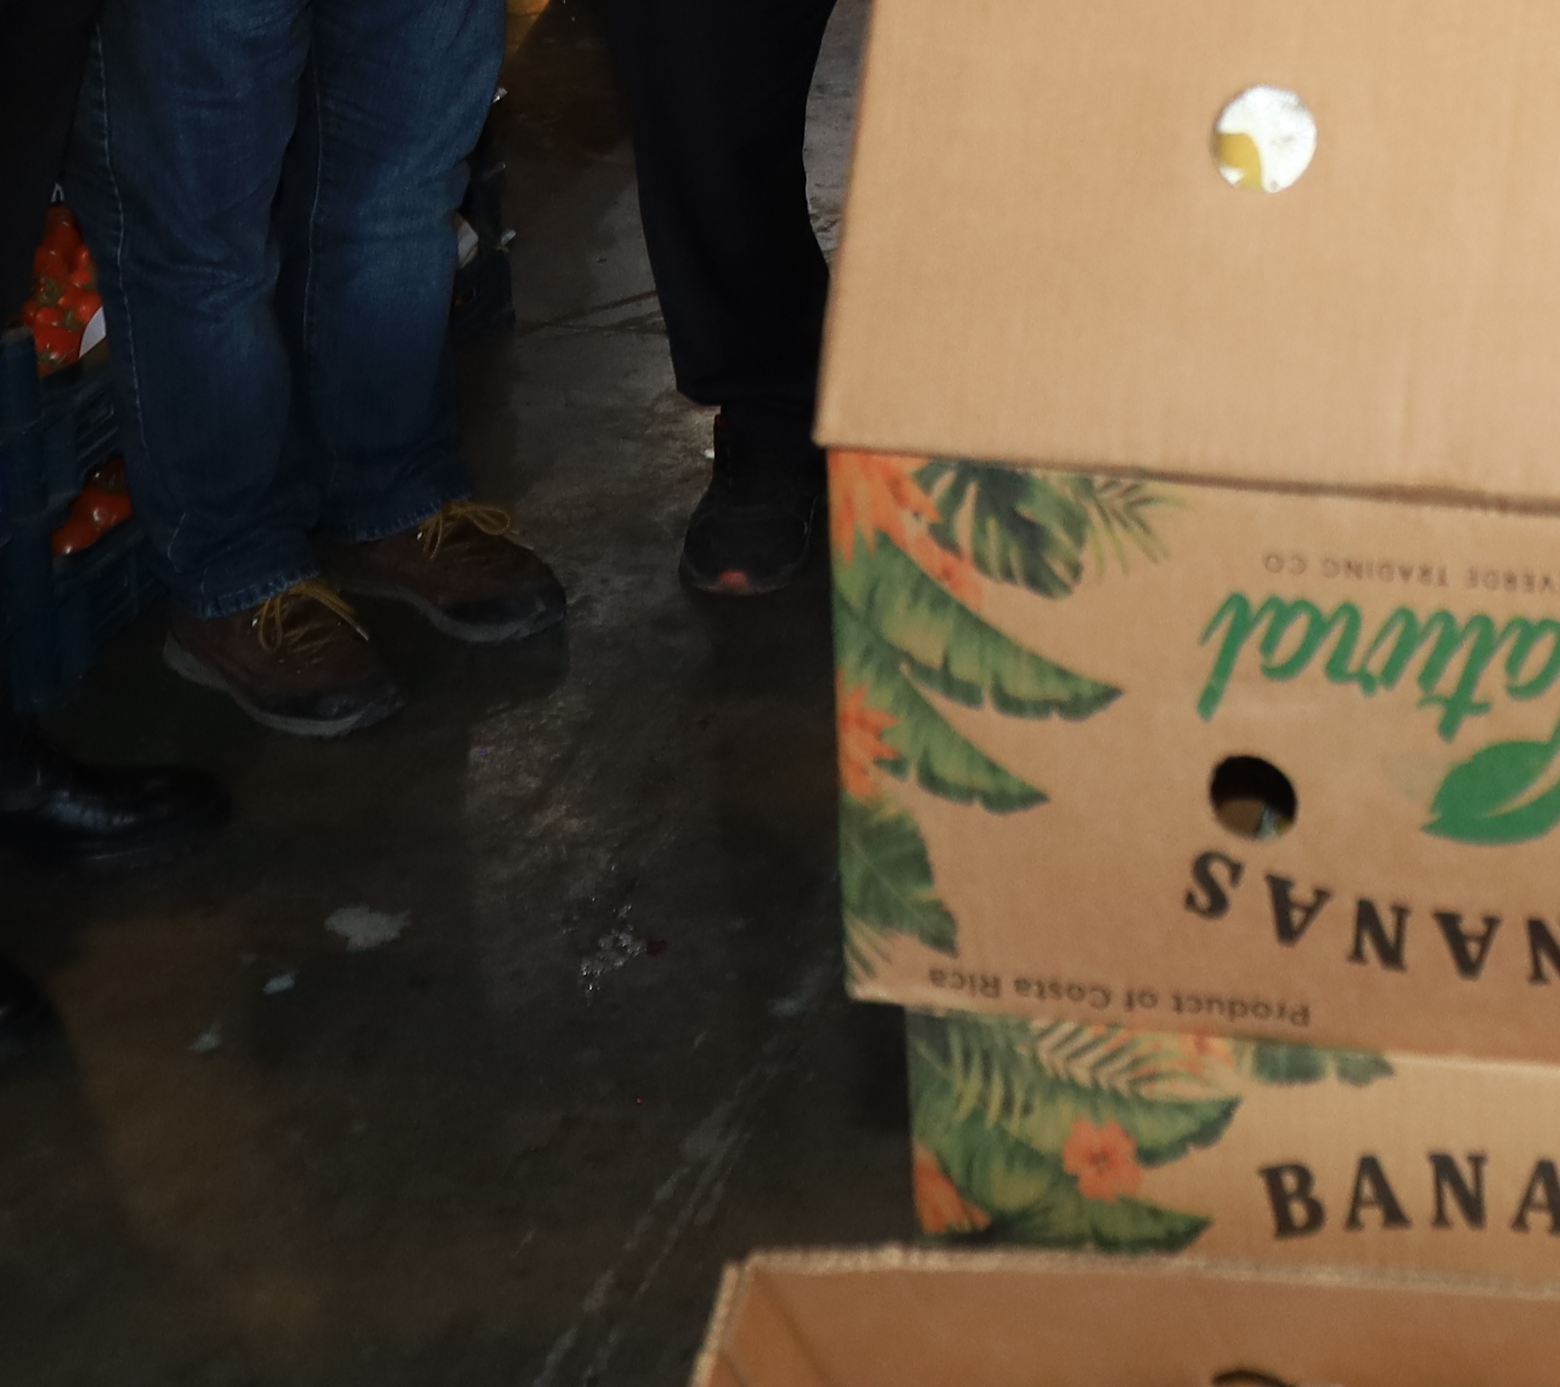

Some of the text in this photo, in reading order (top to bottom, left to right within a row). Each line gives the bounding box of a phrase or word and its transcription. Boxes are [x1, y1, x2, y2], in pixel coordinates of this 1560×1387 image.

[1263, 553, 1307, 576] CO
[1322, 555, 1449, 588] TRADING
[927, 968, 1311, 1028] Product of Costa Rica
